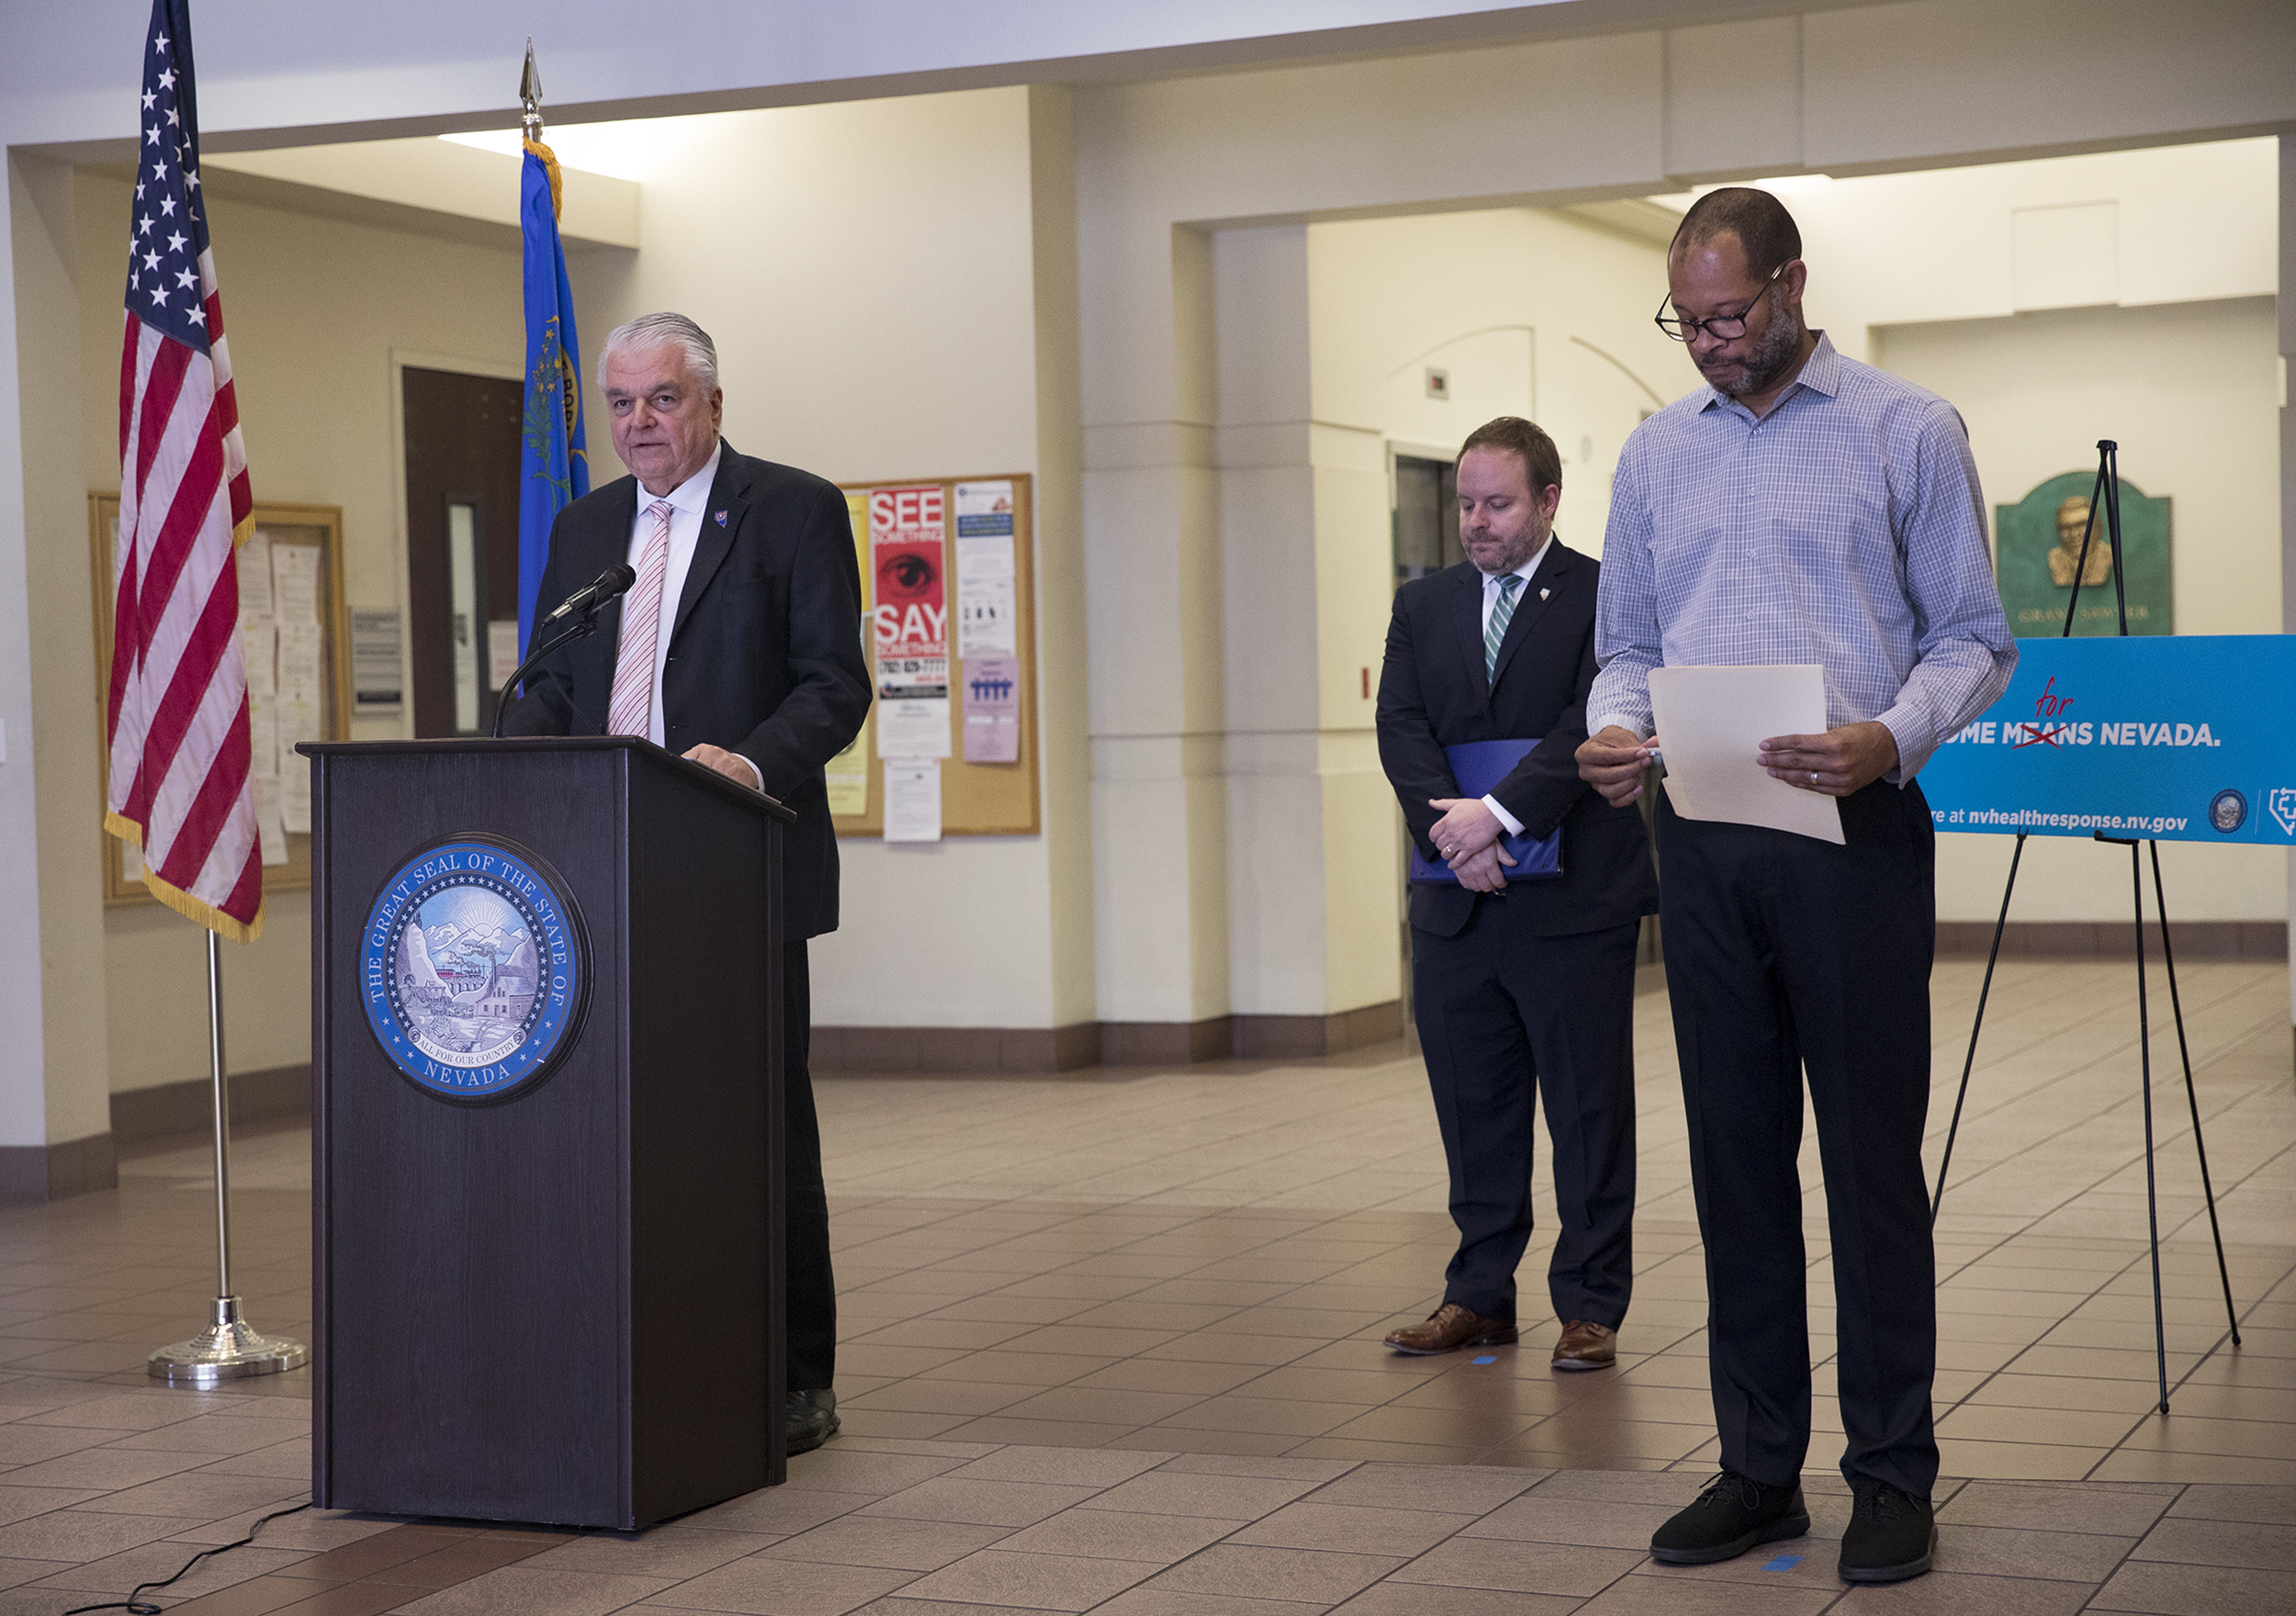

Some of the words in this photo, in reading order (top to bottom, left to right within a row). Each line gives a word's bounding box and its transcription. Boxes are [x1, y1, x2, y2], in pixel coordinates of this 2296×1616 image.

[871, 491, 944, 532] SEE
[874, 602, 948, 643] SAY
[2035, 676, 2074, 717] for
[2099, 723, 2222, 746] NEVADA.
[1931, 810, 1945, 823] re
[1949, 808, 1964, 823] at
[1969, 808, 2188, 833] nvhealthresponse.nv.gov
[413, 853, 461, 885] SEAL
[467, 853, 494, 871] OF
[501, 861, 536, 897] THE
[371, 880, 413, 948] GREAT
[535, 898, 567, 965] STATE
[368, 958, 386, 1004] THE
[550, 975, 567, 1006] OF
[418, 1039, 433, 1054] ALL
[435, 1049, 453, 1062] FOR
[455, 1055, 474, 1065] OUR
[476, 1039, 514, 1063] COUNTRY
[423, 1060, 511, 1086] NEVADA
